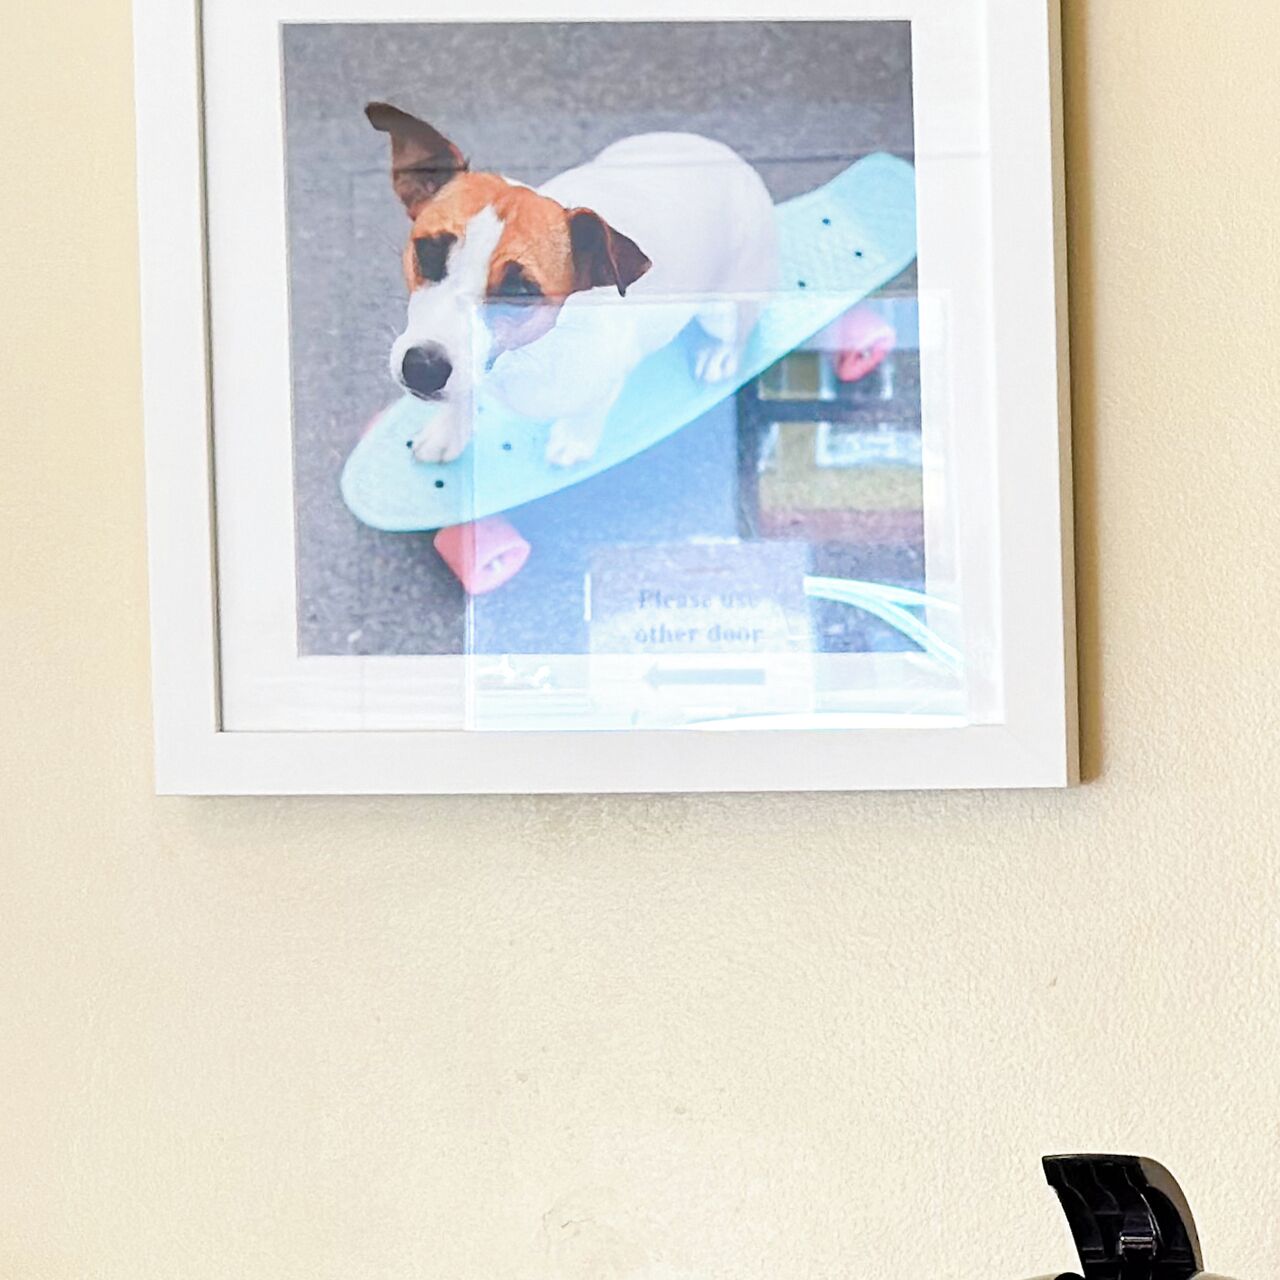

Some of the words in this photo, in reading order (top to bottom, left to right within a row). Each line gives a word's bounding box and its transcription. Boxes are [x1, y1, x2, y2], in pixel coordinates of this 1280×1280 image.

[638, 589, 713, 609] Please
[634, 623, 698, 643] other
[706, 623, 764, 643] door
